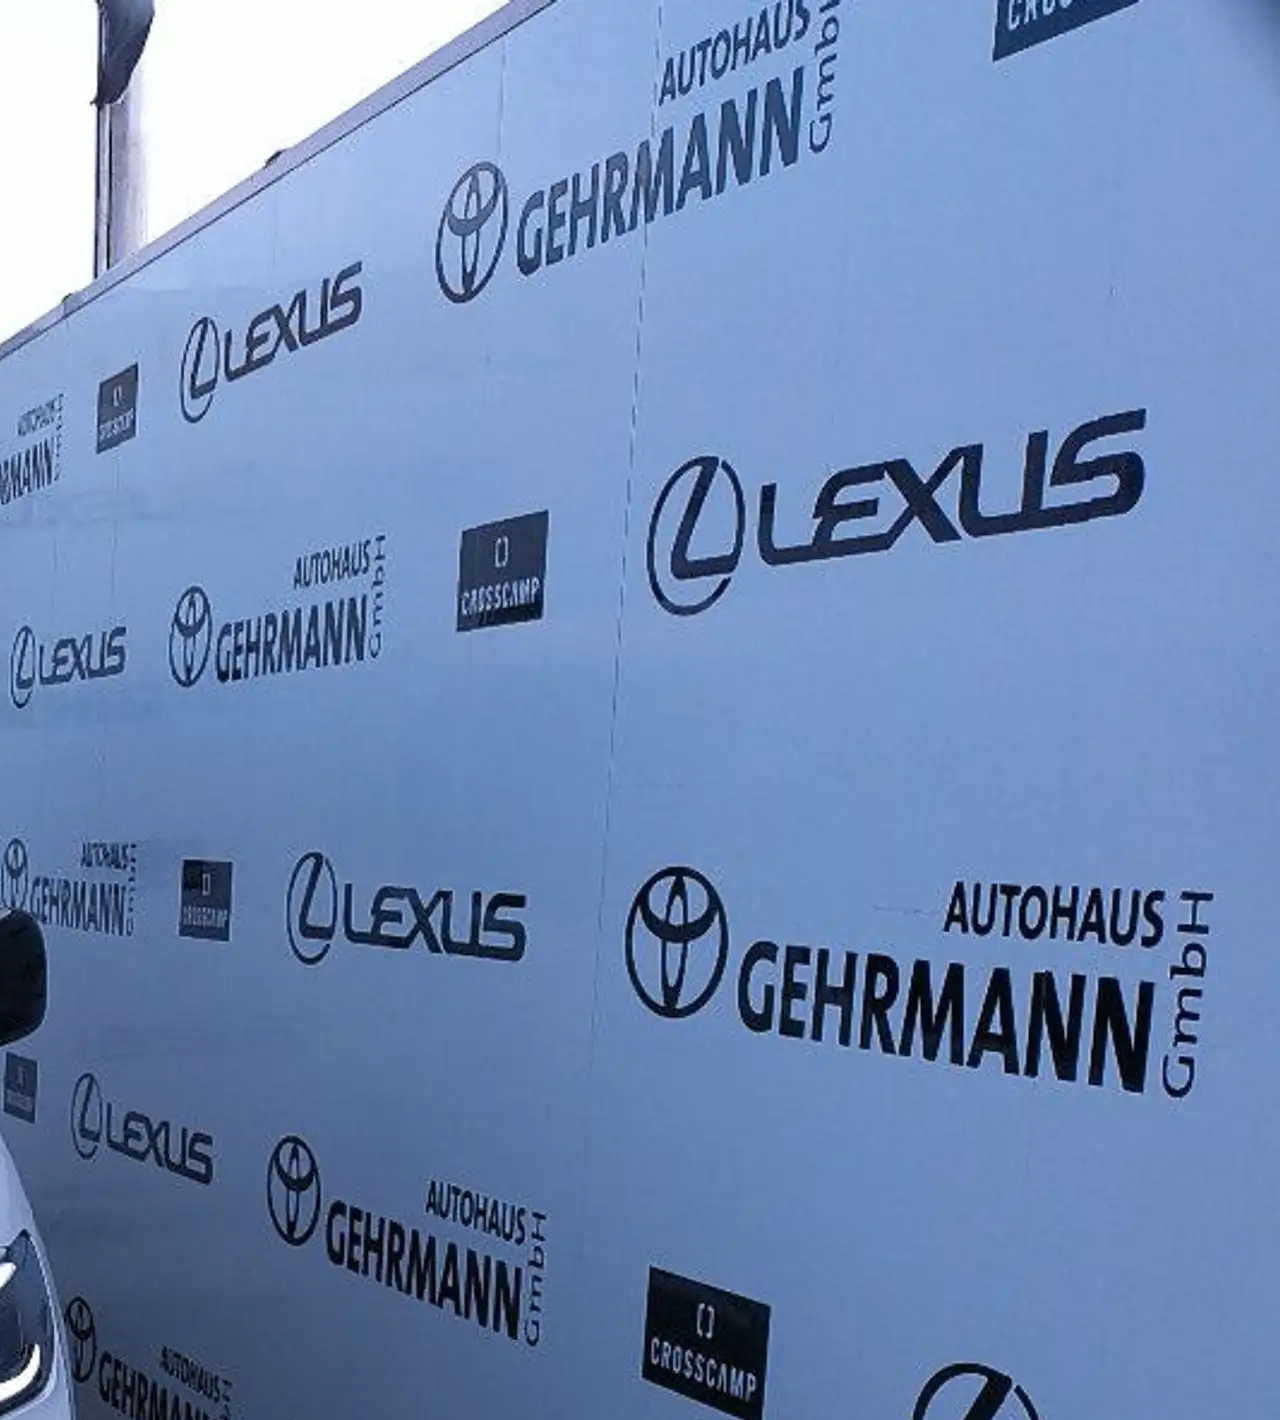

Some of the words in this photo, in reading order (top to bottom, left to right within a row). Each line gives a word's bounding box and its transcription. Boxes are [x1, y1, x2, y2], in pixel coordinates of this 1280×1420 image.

[659, 0, 810, 106] AUTOHAUS
[518, 67, 805, 276] GEHRMANN
[224, 261, 362, 382] LEXUS
[757, 408, 1147, 566] LEXUS
[293, 539, 371, 591] AUTOHAUS
[38, 626, 127, 685] LEXUS
[215, 594, 368, 683] GEHRMANN
[31, 876, 127, 937] GEHRMANN
[344, 882, 527, 962] LEXUS
[944, 881, 1165, 949] AUTOHAUS
[737, 941, 1156, 1094] GEHRMANN
[1162, 890, 1215, 1099] GmbH
[104, 1101, 214, 1185] LEXUS
[426, 1180, 526, 1245] AUTOHAUS
[326, 1200, 522, 1341] GEHRMANN
[523, 1211, 547, 1347] GmbH
[650, 1337, 757, 1402] CROSSCAMP
